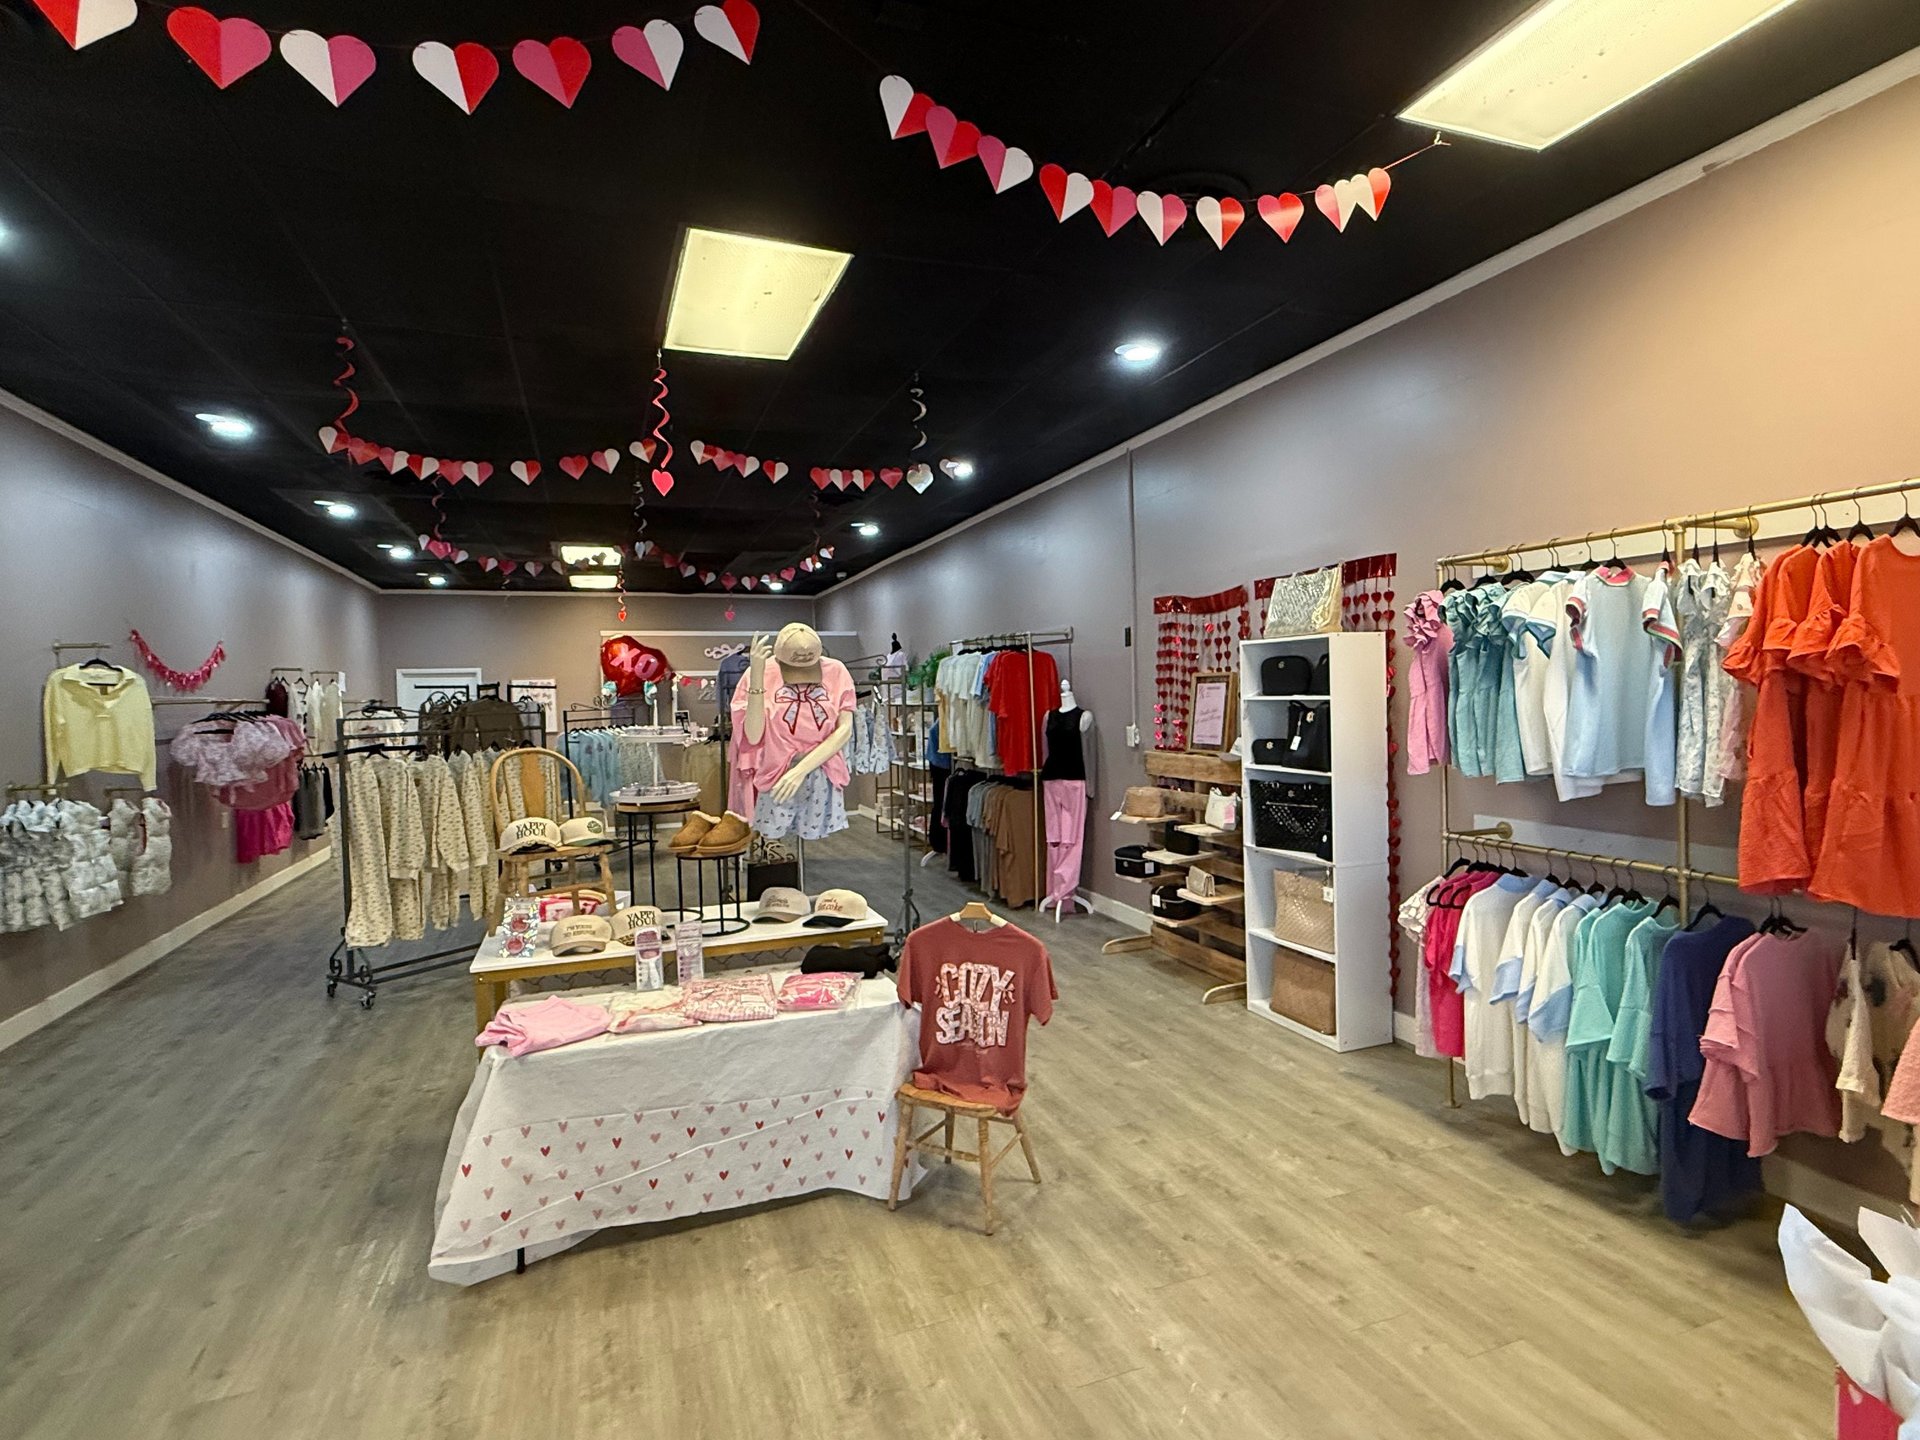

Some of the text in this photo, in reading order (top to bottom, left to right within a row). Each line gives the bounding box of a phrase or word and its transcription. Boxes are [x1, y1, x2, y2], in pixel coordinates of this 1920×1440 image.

[610, 642, 659, 681] XO
[516, 821, 547, 832] YAPPY
[516, 828, 547, 839] HOUR
[628, 917, 658, 929] HOUR
[940, 962, 1016, 1012] COZY
